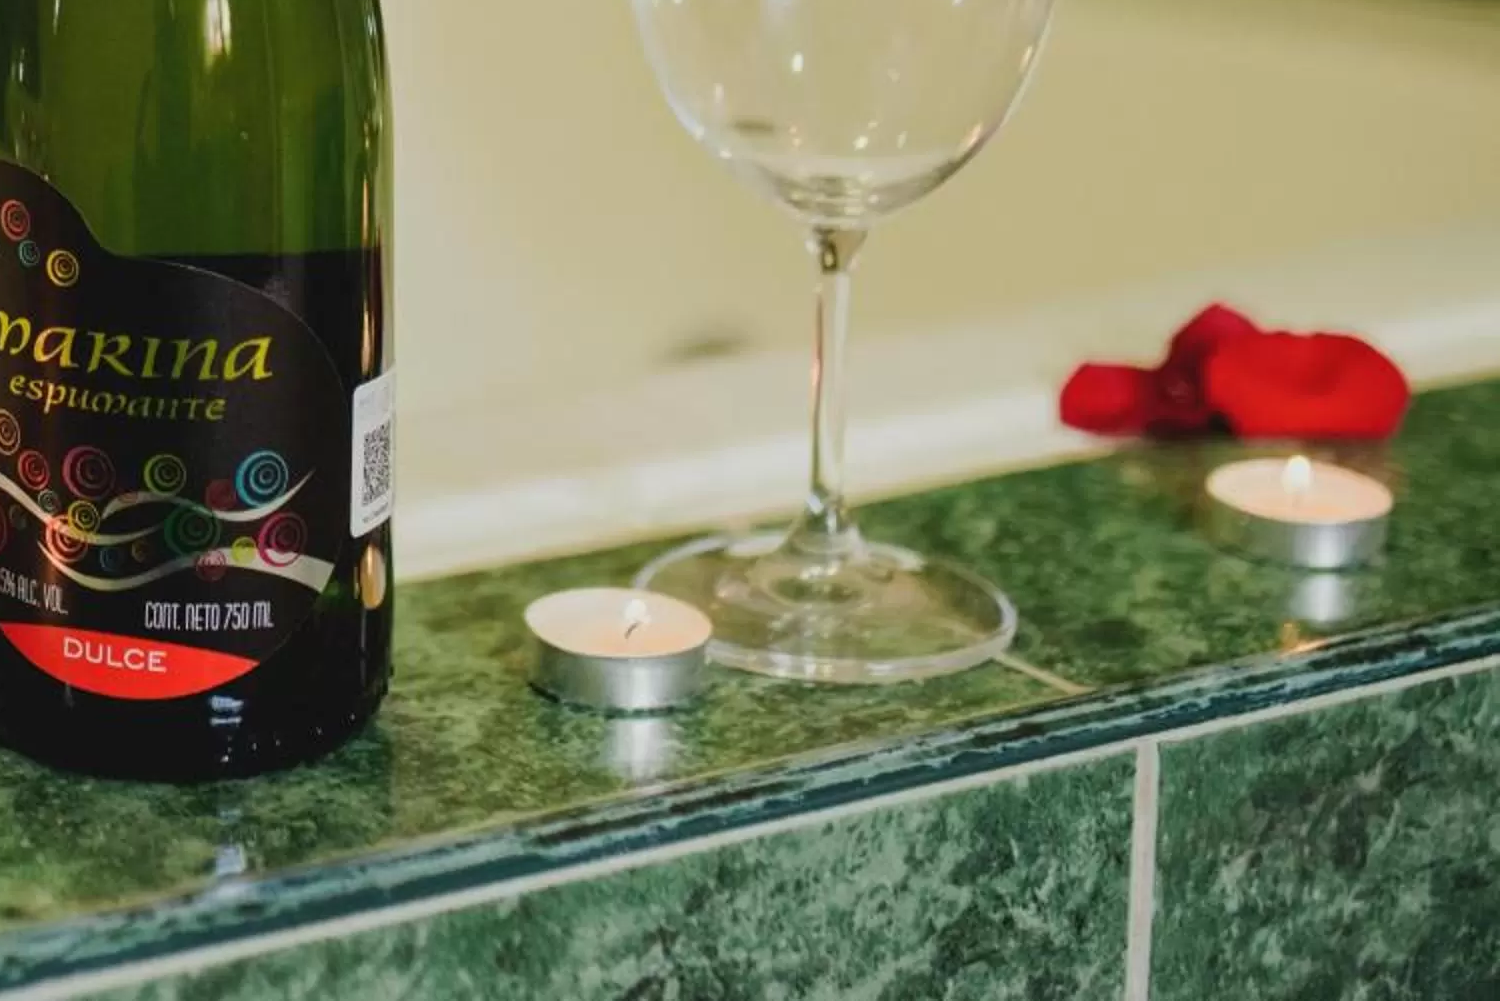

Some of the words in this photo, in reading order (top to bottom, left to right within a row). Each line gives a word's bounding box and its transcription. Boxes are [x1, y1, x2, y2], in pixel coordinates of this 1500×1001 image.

[144, 600, 181, 630] CONT.
[185, 602, 220, 631] NETO
[223, 601, 250, 631] 750
[252, 600, 275, 629] ML
[62, 636, 168, 674] DULCE
